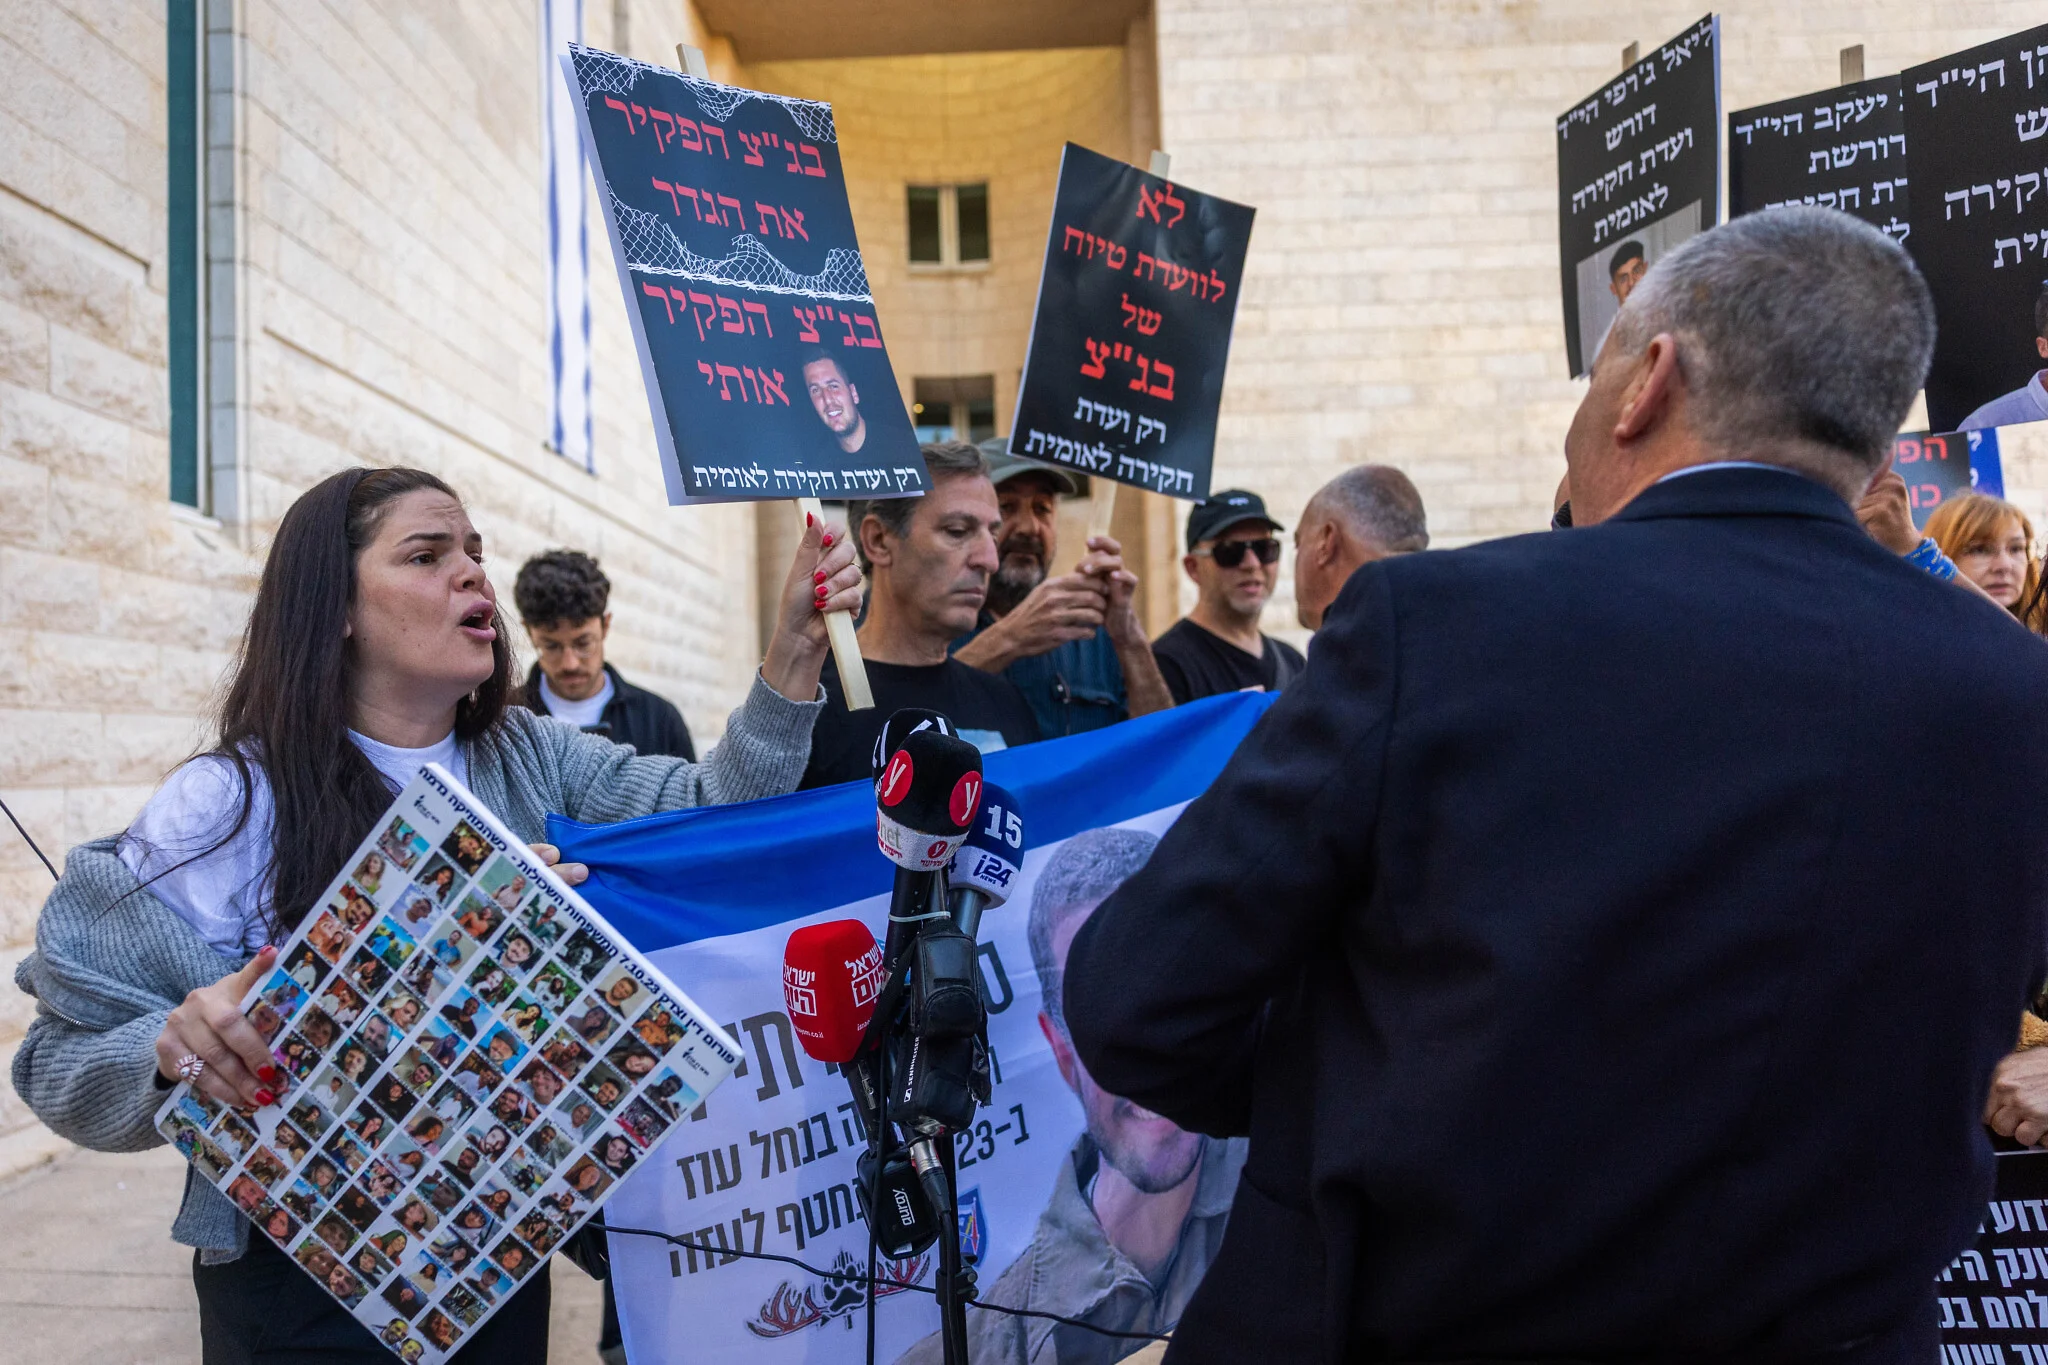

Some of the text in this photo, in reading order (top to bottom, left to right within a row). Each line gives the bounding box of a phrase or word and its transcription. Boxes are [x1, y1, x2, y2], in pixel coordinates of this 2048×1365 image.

[604, 95, 827, 178] בג"צ הפקיר
[1605, 103, 1657, 152] דורש
[1814, 93, 1888, 132] יעקב
[1573, 127, 1693, 214] ועדת חקירה
[652, 177, 810, 242] את הגדר
[1136, 182, 1185, 229] לא
[1594, 182, 1669, 243] לאומית
[1064, 225, 1226, 303] לוועדת טיוח
[642, 282, 883, 349] בג"צ הפקיר
[1121, 293, 1162, 336] של
[697, 358, 790, 407] אותי
[1080, 337, 1175, 401] בג"צ
[1074, 397, 1167, 444] רק ועדת
[693, 461, 922, 497] רק ועדת חקירה לאומית
[1025, 429, 1194, 493] חקירה לאומית
[984, 804, 1022, 849] 15
[518, 860, 564, 906] השכולות
[973, 854, 1014, 888] i24
[564, 903, 618, 957] המשפחות
[619, 954, 660, 995] 7.10.23
[658, 993, 687, 1020] וצדק
[685, 1018, 704, 1035] דין
[703, 1033, 735, 1064] פורום
[908, 1036, 920, 1086] SENNHEISER
[749, 1111, 838, 1180] בנחל
[676, 1143, 742, 1200] עוז
[667, 1207, 765, 1278] לעזה
